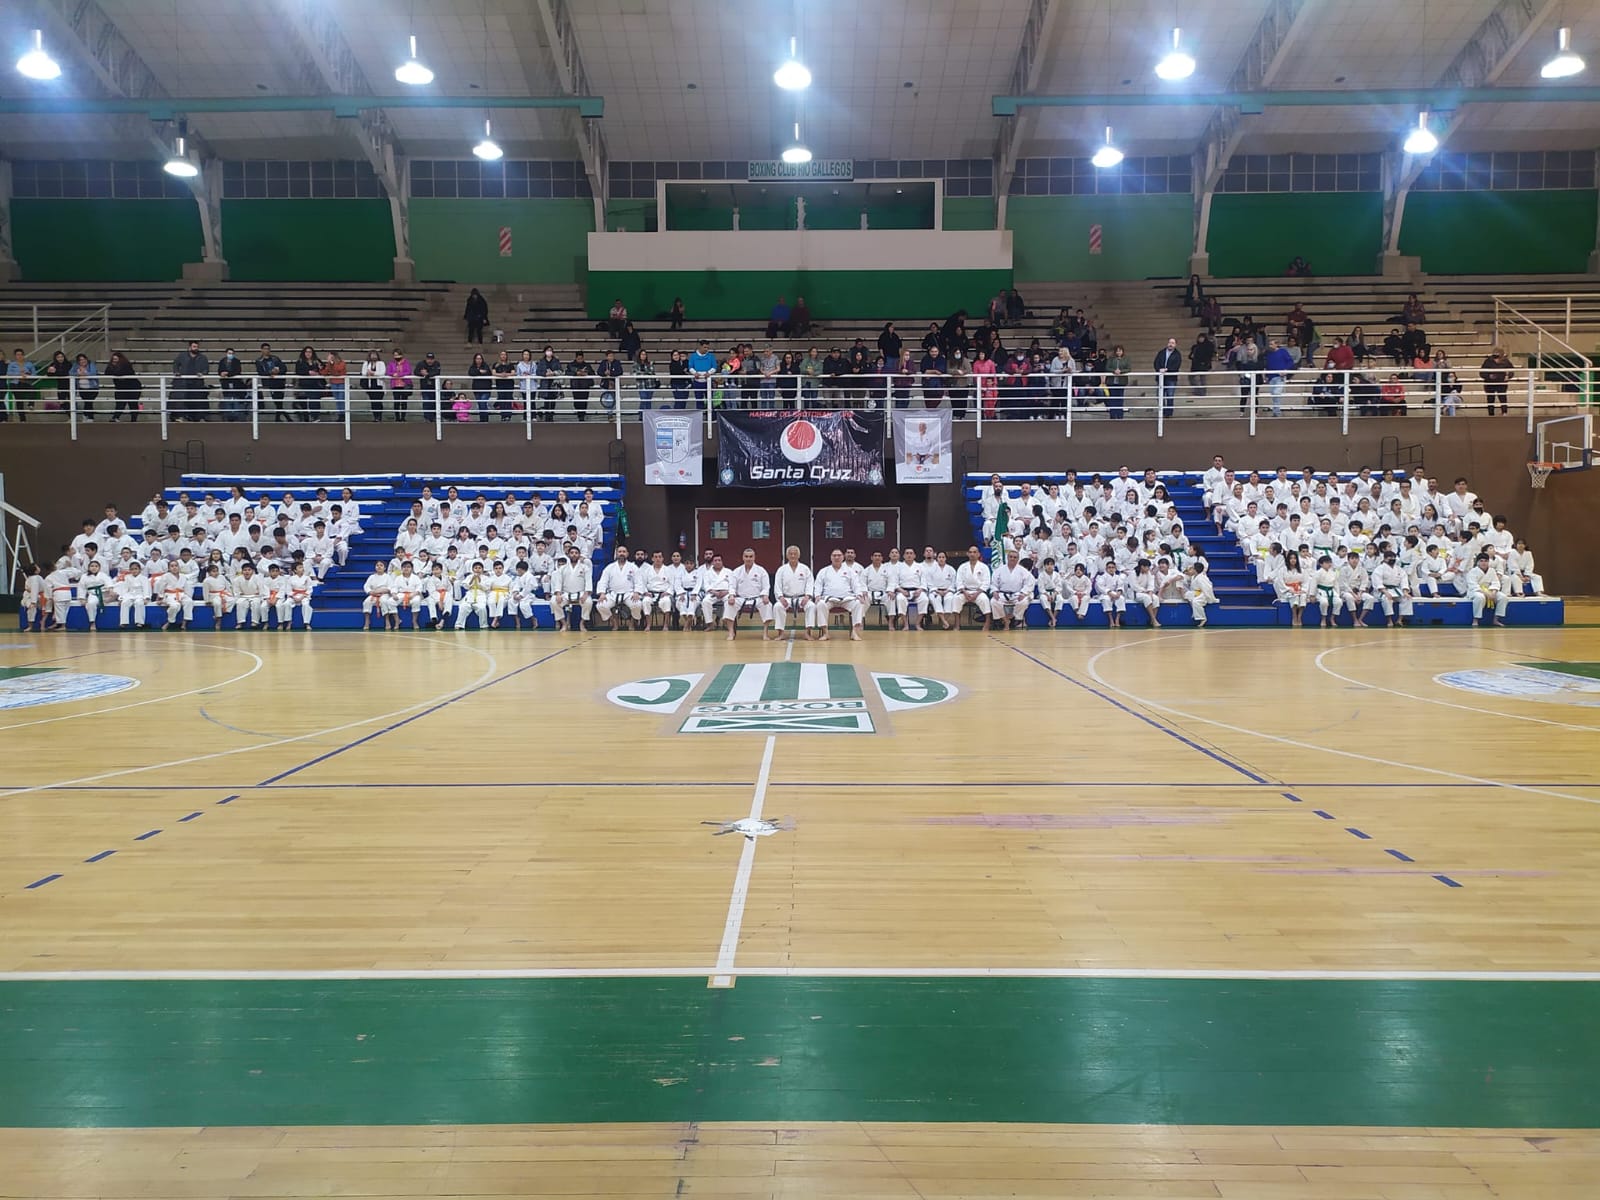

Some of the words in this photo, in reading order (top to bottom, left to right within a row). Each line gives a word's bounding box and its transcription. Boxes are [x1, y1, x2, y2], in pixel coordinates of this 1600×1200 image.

[749, 162, 776, 177] BOXING
[777, 162, 797, 177] CLUB
[812, 162, 851, 177] GALLEGOS
[750, 465, 805, 480] Santa
[810, 465, 853, 481] Cruz
[699, 701, 863, 713] BOXING
